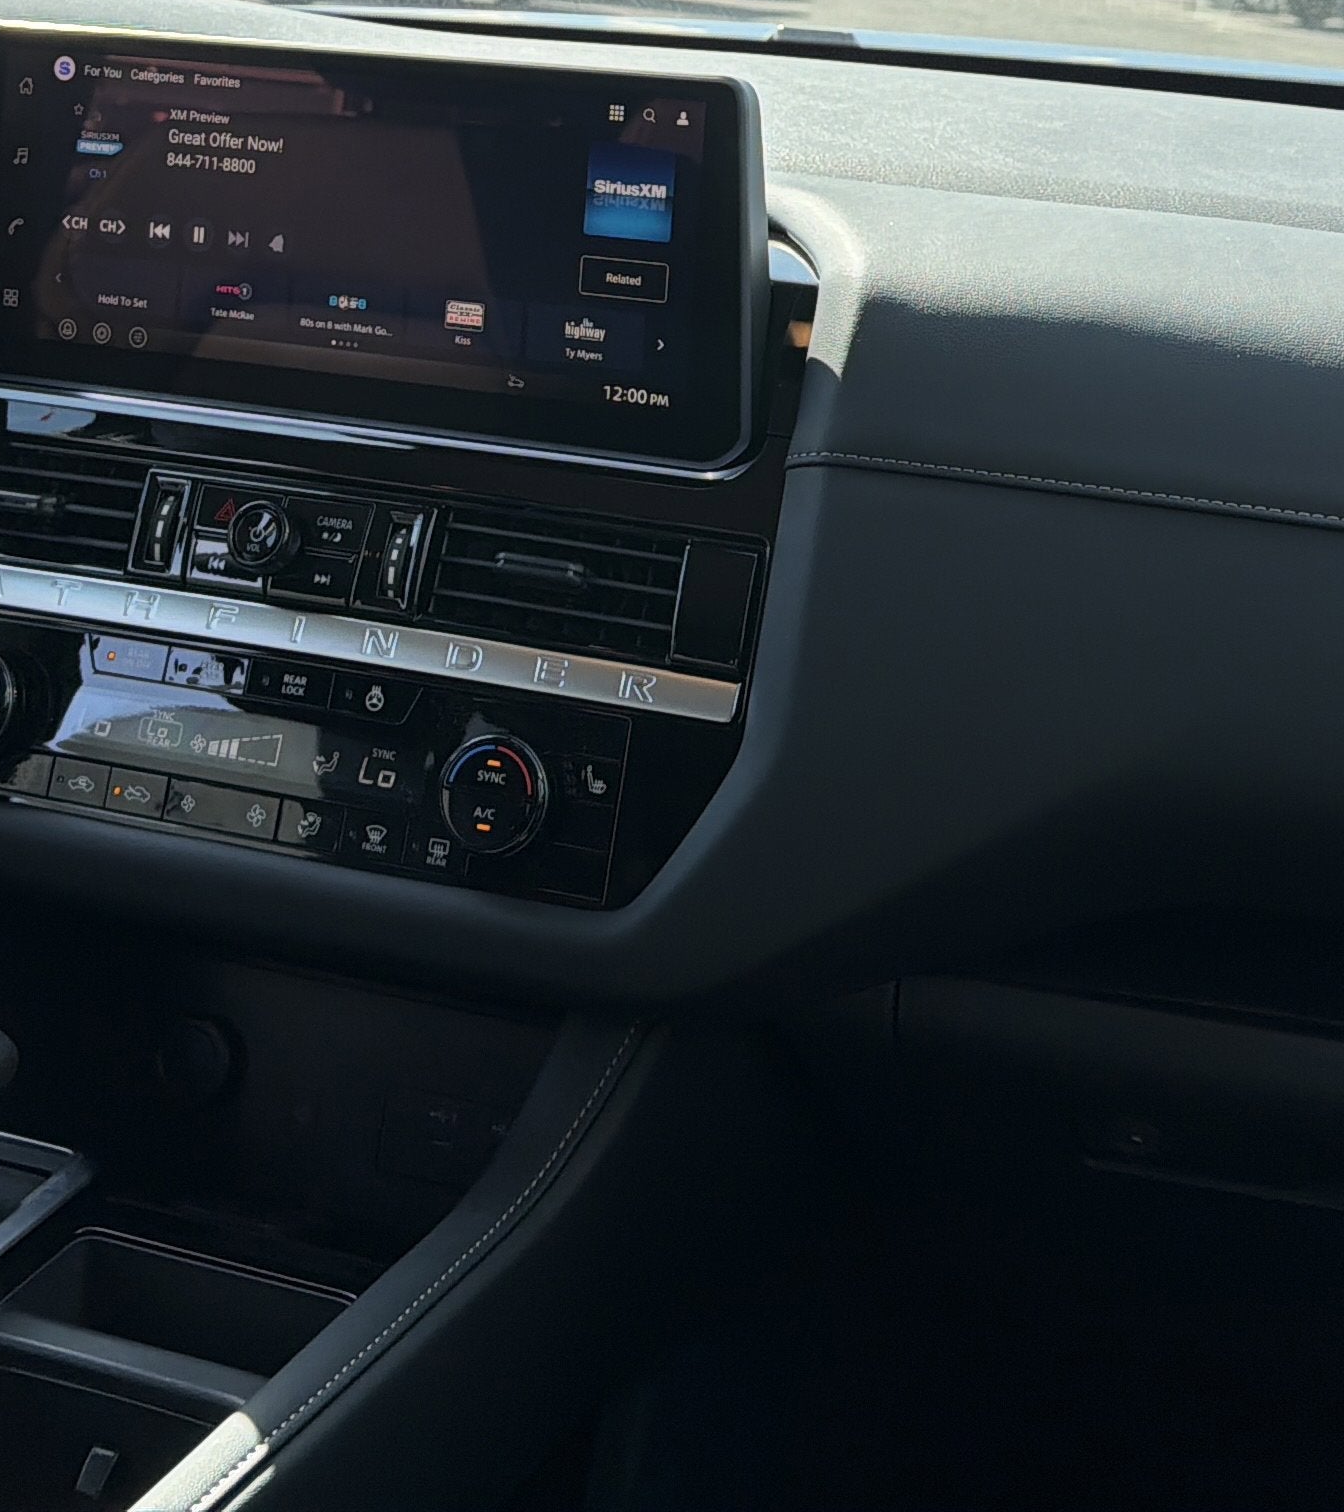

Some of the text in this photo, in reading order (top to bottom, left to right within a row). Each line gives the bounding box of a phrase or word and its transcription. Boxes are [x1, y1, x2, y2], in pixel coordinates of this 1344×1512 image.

[84, 65, 241, 88] For You Categories Favorites
[169, 109, 230, 125] XM Preview
[168, 129, 284, 153] Great Offer Now!
[166, 153, 256, 174] 844-711-8800
[594, 179, 667, 200] SiriusXM
[605, 273, 642, 286] Related
[97, 294, 148, 309] Hold To Set
[334, 321, 352, 333] with
[353, 323, 373, 335] Mark
[564, 321, 606, 341] highway
[454, 335, 471, 347] Kiss
[565, 348, 603, 362] Ty Myers
[603, 385, 670, 407] 12:00 PM
[316, 516, 353, 530] CAMERA
[283, 674, 307, 685] REAR
[281, 685, 305, 696] LOCK
[372, 748, 397, 761] SYNC
[358, 756, 396, 788] Lo
[477, 770, 506, 785] SYNC
[473, 806, 496, 820] A/C
